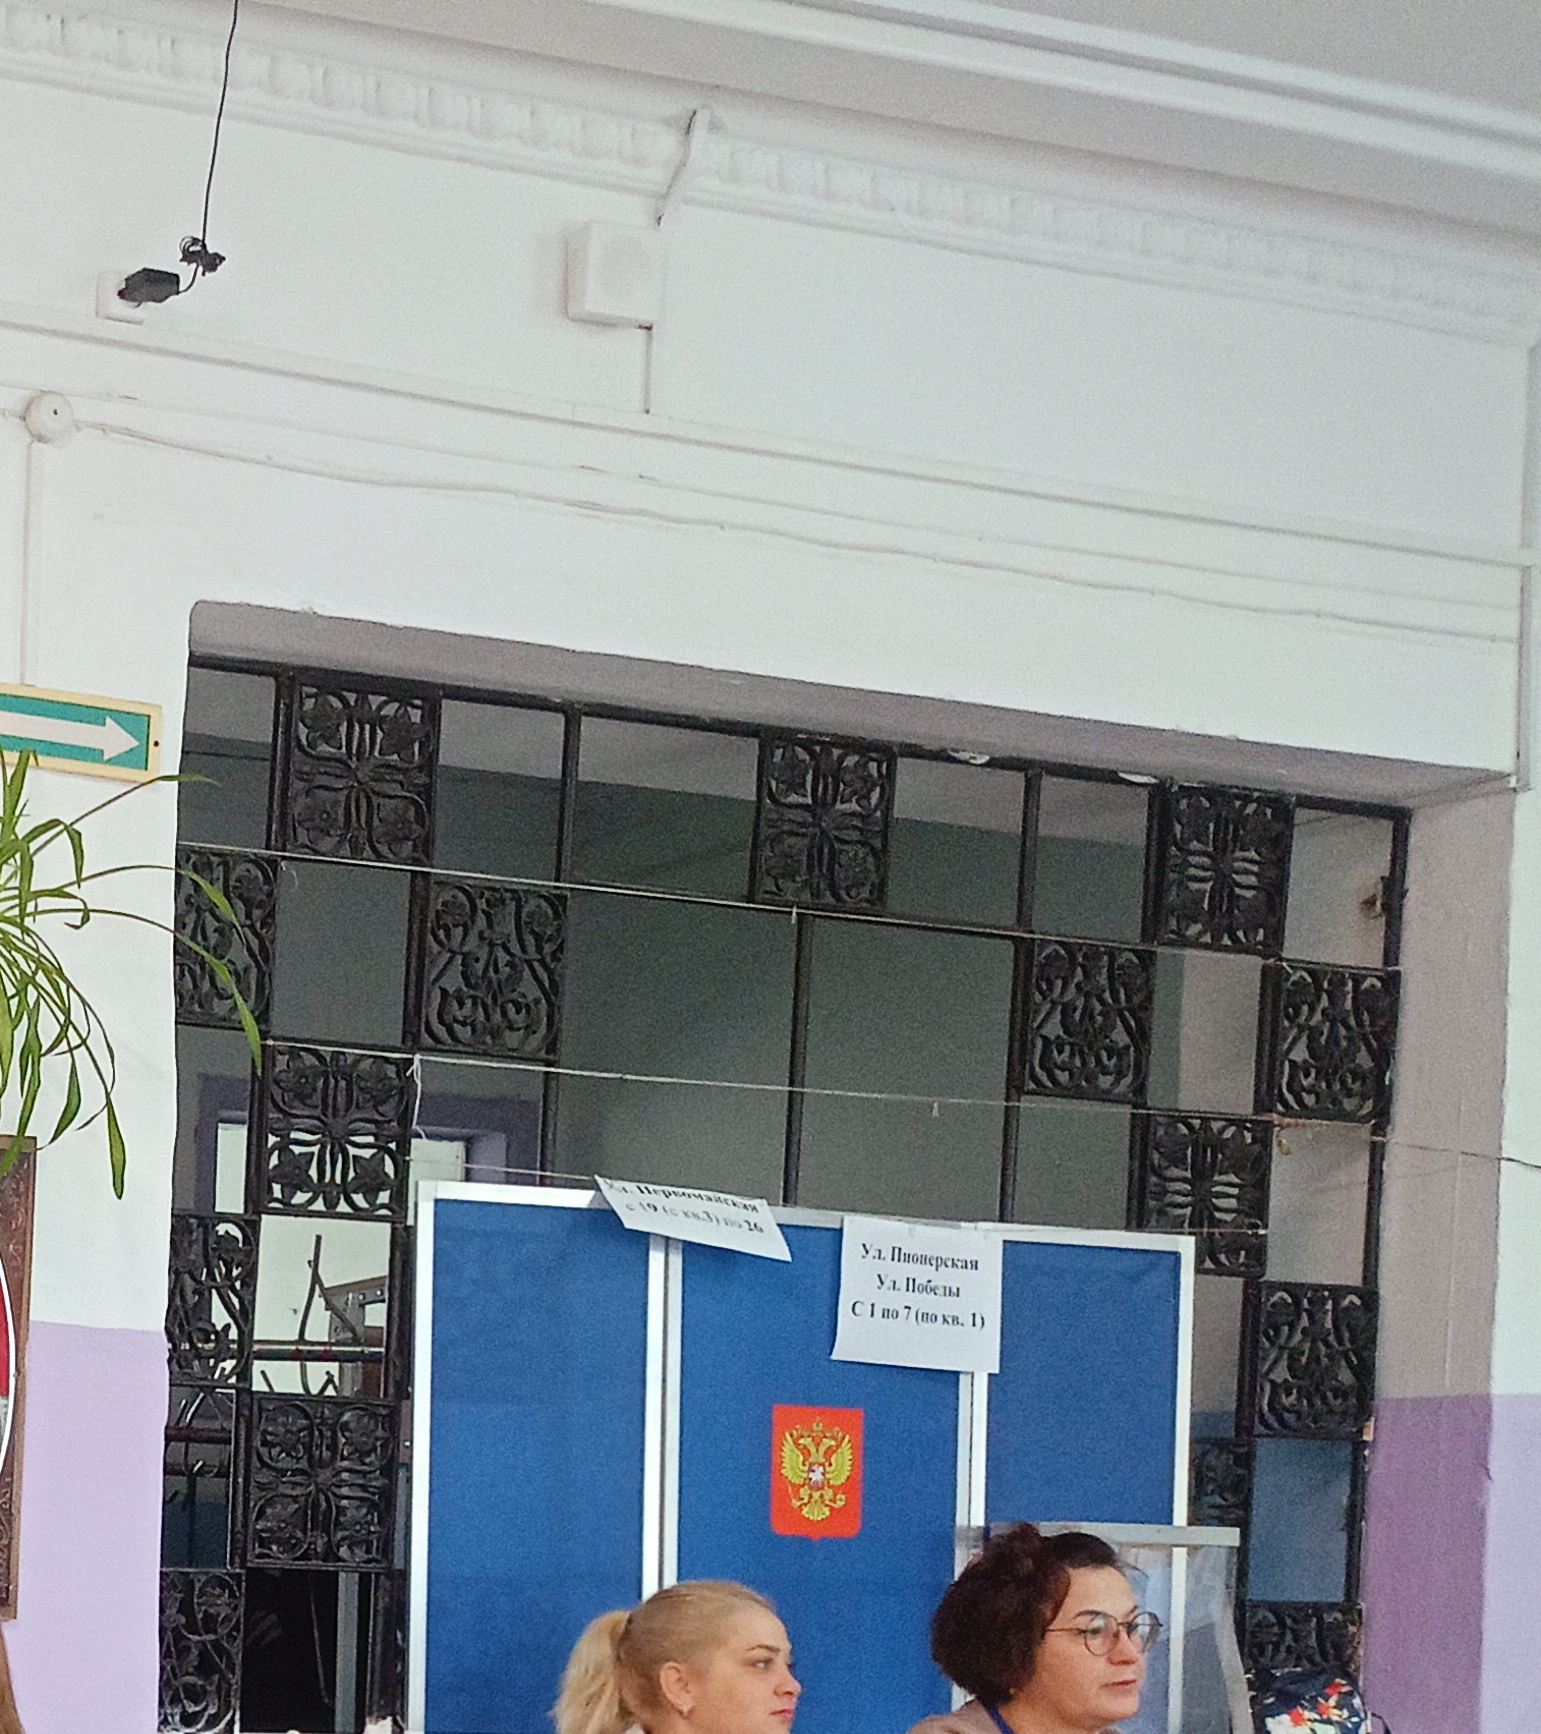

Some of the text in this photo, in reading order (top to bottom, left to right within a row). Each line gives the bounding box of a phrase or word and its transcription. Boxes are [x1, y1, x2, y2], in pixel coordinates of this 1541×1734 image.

[636, 1185, 760, 1213] Первомайская
[639, 1201, 658, 1213] 19
[743, 1219, 764, 1234] 26
[861, 1242, 979, 1272] Ул. Пионерская
[876, 1273, 961, 1298] Ул. Победы
[869, 1302, 876, 1318] 1
[881, 1307, 899, 1320] по
[903, 1305, 912, 1321] 7
[914, 1307, 938, 1326] (по
[941, 1314, 965, 1327] кв.
[970, 1312, 986, 1330] 1)
